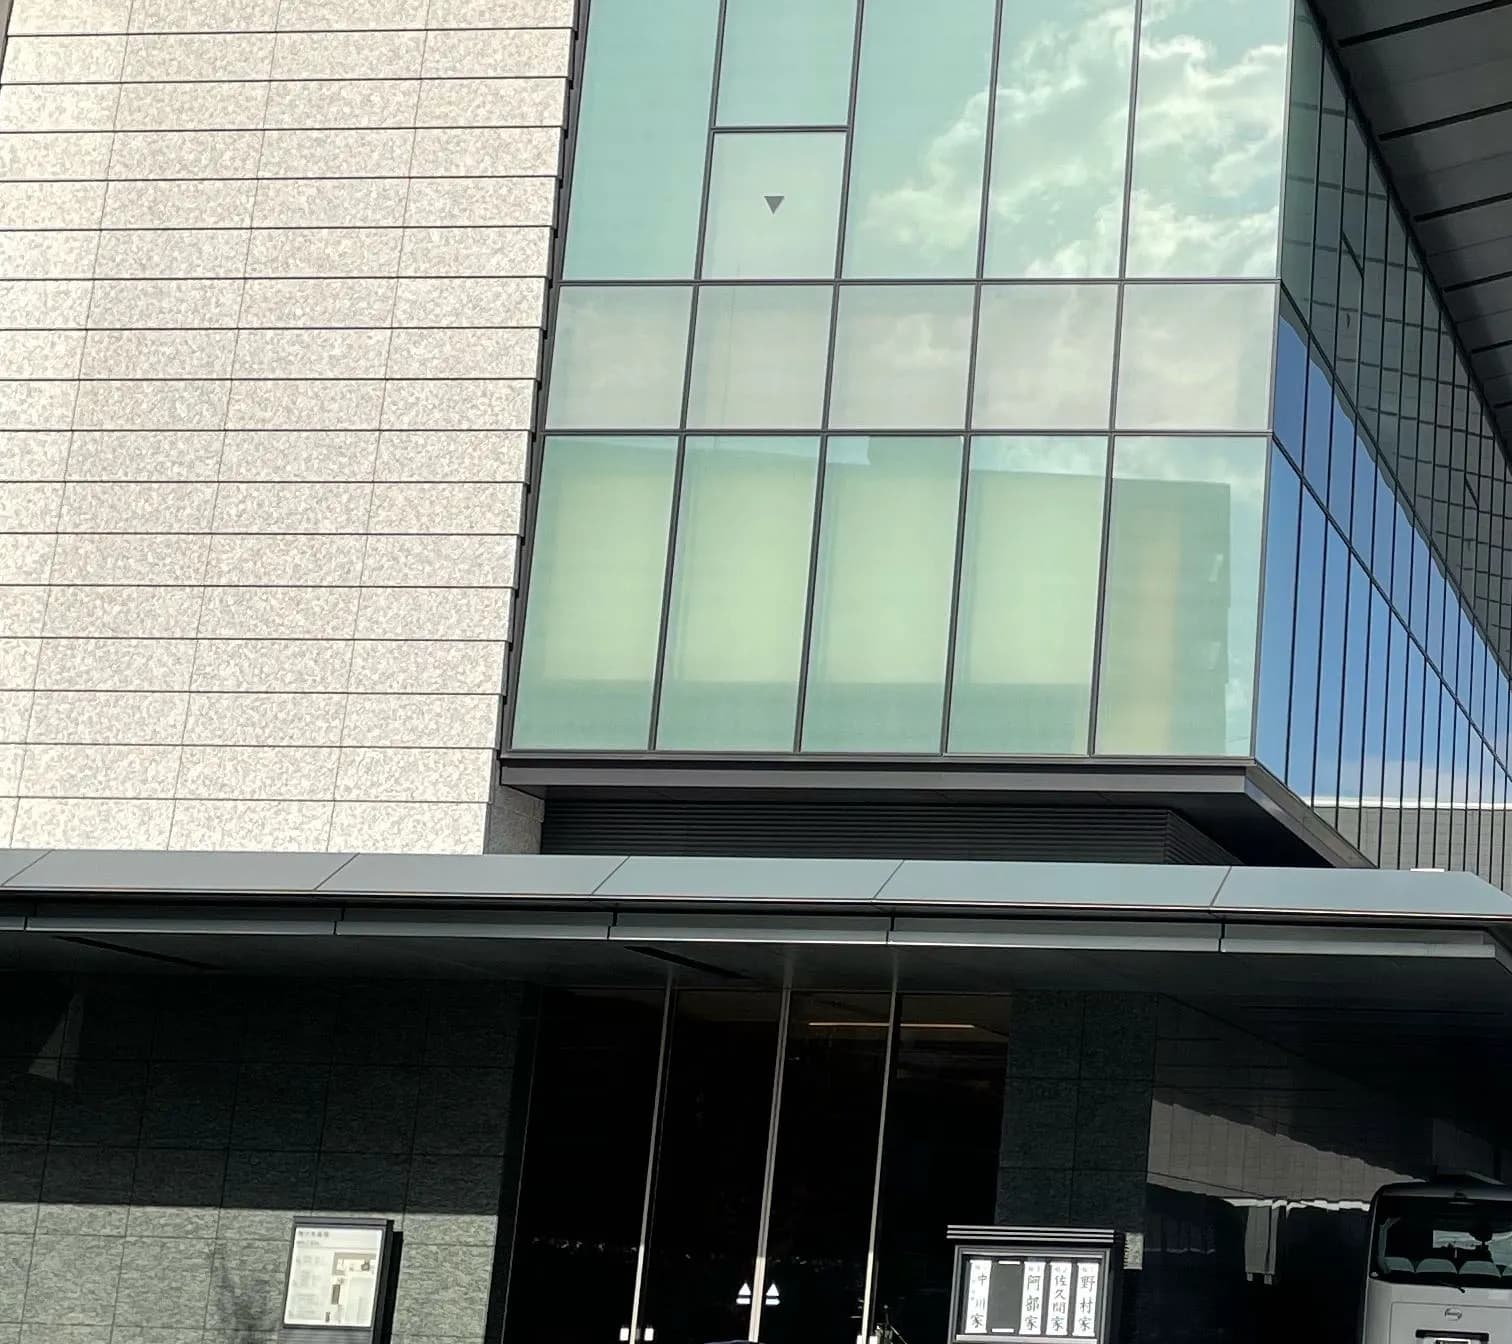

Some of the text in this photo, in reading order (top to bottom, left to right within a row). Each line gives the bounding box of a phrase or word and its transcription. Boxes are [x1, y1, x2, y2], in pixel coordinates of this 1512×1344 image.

[970, 1272, 988, 1329] 中川家
[1024, 1274, 1041, 1331] 阿部家
[1051, 1274, 1068, 1332] 佐久間家
[1078, 1275, 1096, 1332] 野村家
